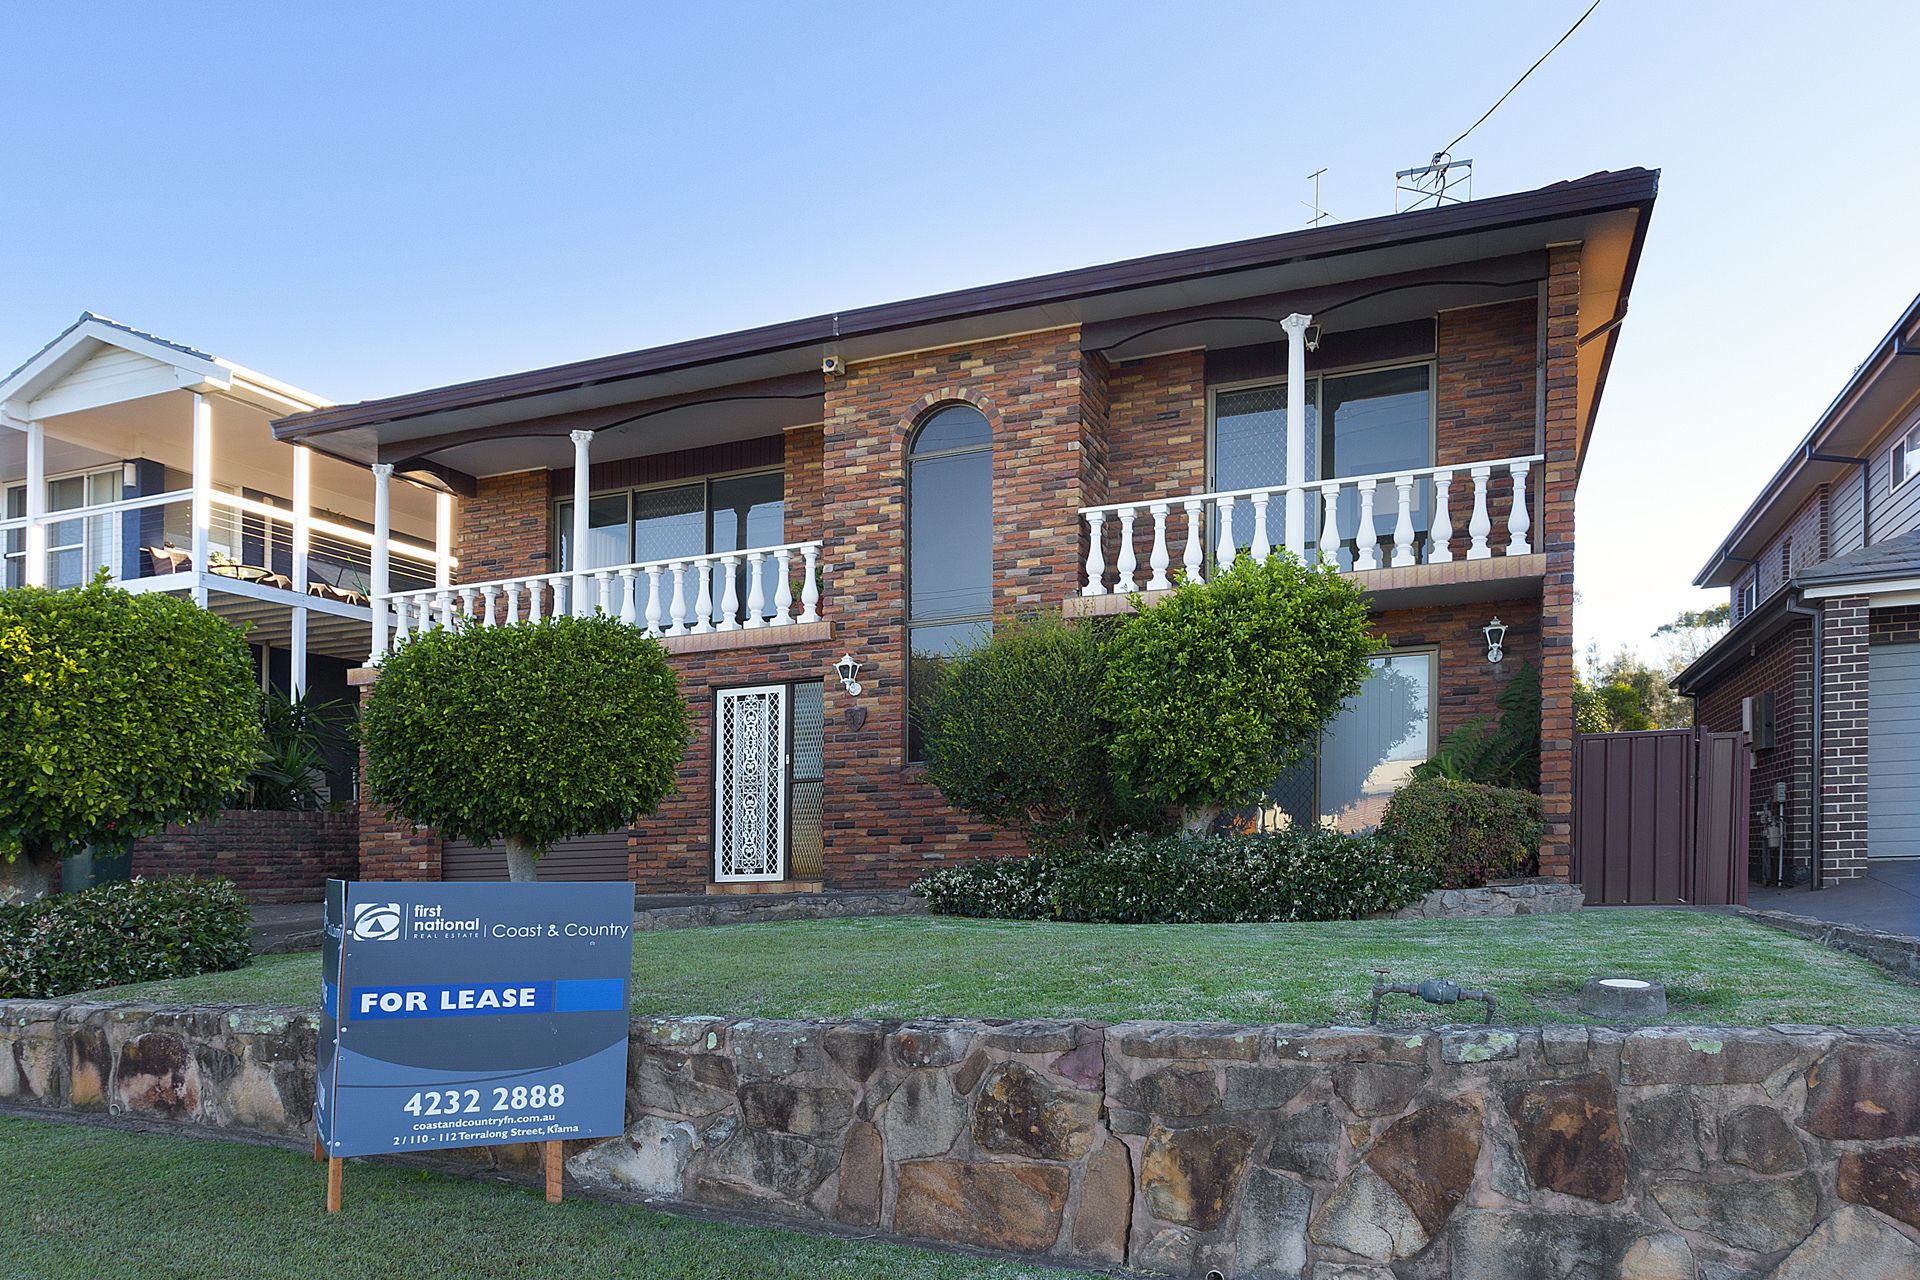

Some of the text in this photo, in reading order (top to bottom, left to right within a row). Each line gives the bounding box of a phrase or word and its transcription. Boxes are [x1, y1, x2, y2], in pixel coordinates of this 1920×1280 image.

[414, 904, 442, 917] first
[414, 918, 480, 931] national
[492, 922, 629, 939] Coast & Country
[360, 988, 536, 1013] FOR LEASE
[403, 1084, 565, 1117] 4232 2888
[413, 1113, 556, 1131] coastandcountryfn.com.au
[393, 1136, 400, 1146] 2
[411, 1134, 428, 1144] 110
[439, 1132, 457, 1142] 112
[458, 1129, 508, 1141] Terralong
[510, 1126, 545, 1137] Street,
[547, 1124, 579, 1134] Kiama
